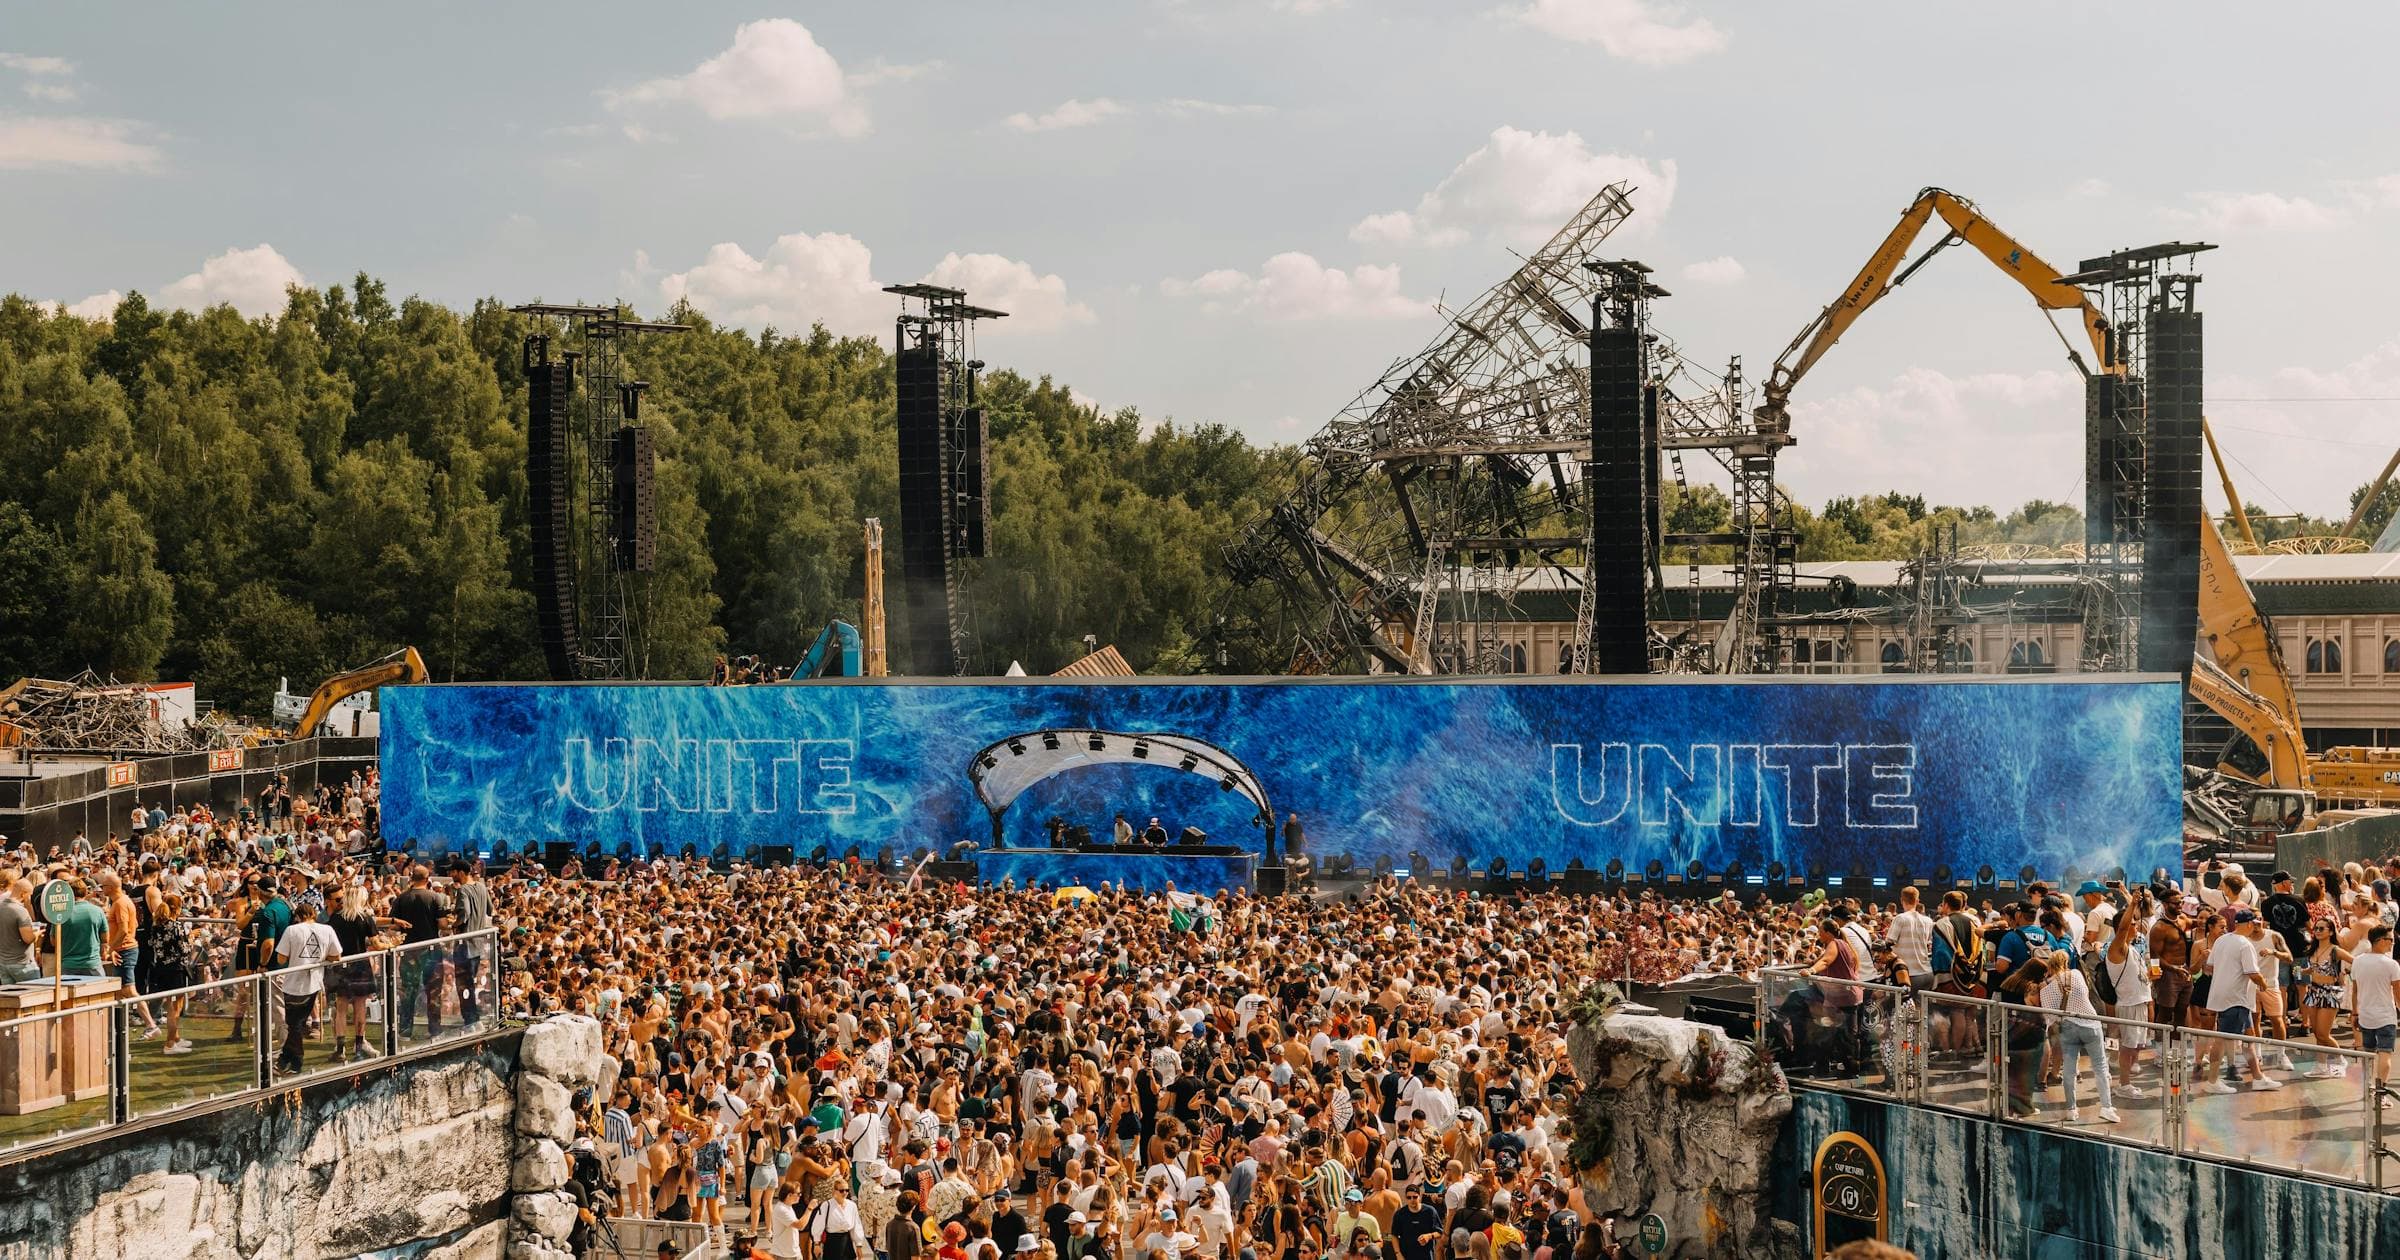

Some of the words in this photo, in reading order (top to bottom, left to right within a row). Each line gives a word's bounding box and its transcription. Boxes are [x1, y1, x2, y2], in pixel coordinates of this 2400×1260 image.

[1860, 275, 1875, 293] LOO
[2191, 681, 2203, 695] VAN
[2203, 689, 2216, 703] LOO
[2214, 696, 2245, 720] PROJECTS
[219, 757, 232, 768] EXIT
[117, 770, 127, 783] EXIT
[564, 737, 856, 814] UNITE
[1551, 742, 1918, 828] UNITE
[1834, 1162, 1845, 1173] CUP
[1844, 1164, 1865, 1177] RETURN
